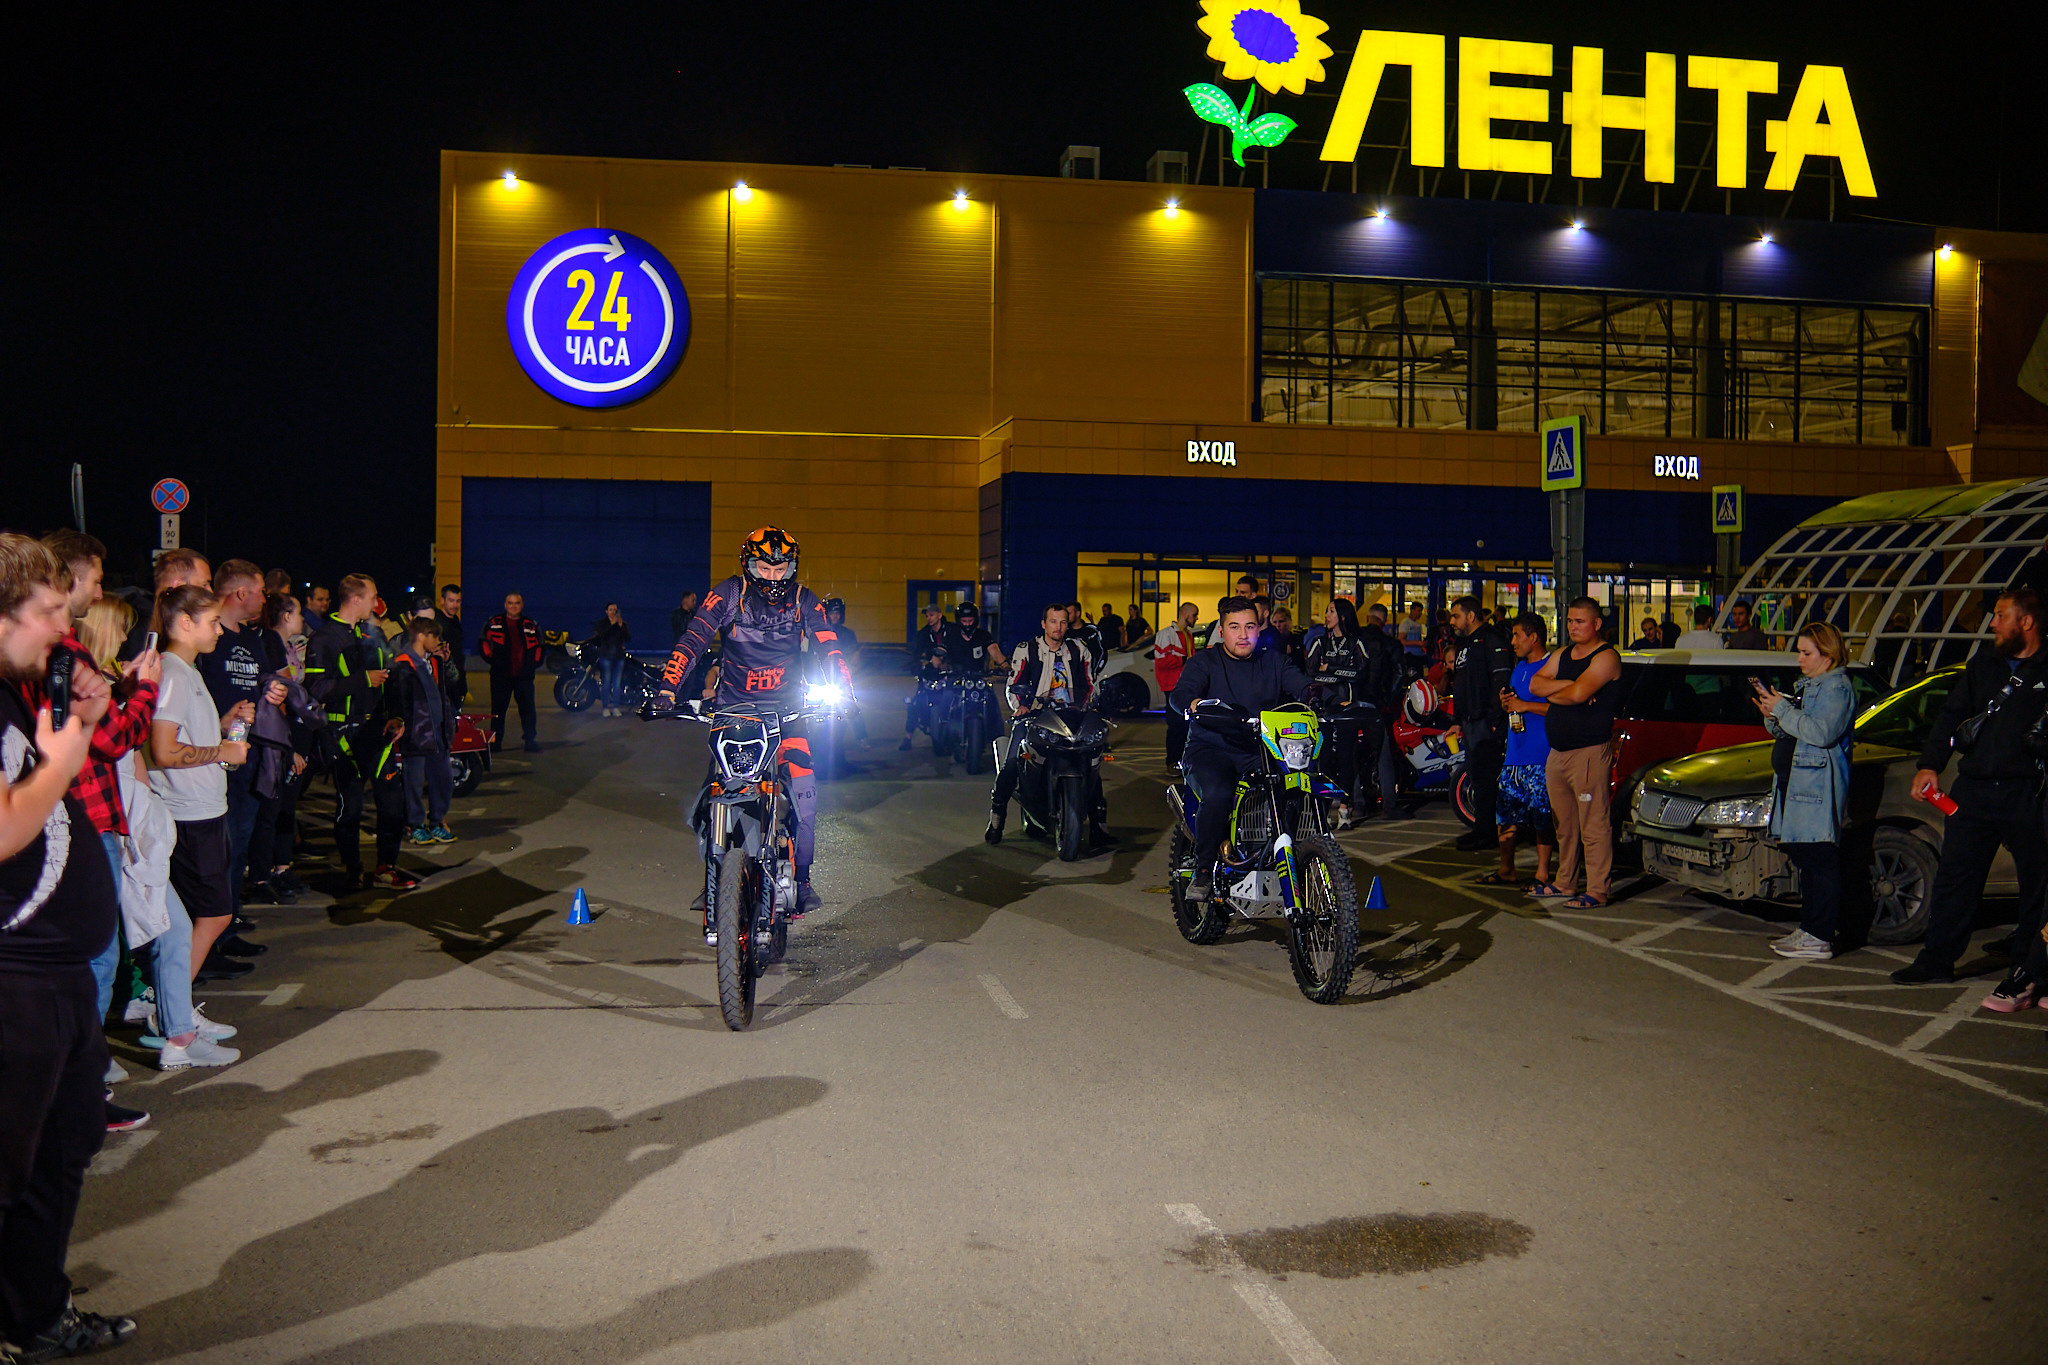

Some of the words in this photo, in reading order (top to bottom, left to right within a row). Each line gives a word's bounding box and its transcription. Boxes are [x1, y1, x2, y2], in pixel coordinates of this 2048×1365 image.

[1319, 29, 1878, 198] ЛЕНТА
[566, 269, 632, 332] 24
[565, 335, 631, 367] ЧАСА
[1187, 440, 1237, 467] ВХОД
[1654, 455, 1699, 481] ВХОД
[165, 530, 176, 538] 90
[226, 660, 260, 675] MUSTANG
[745, 673, 784, 691] FOX
